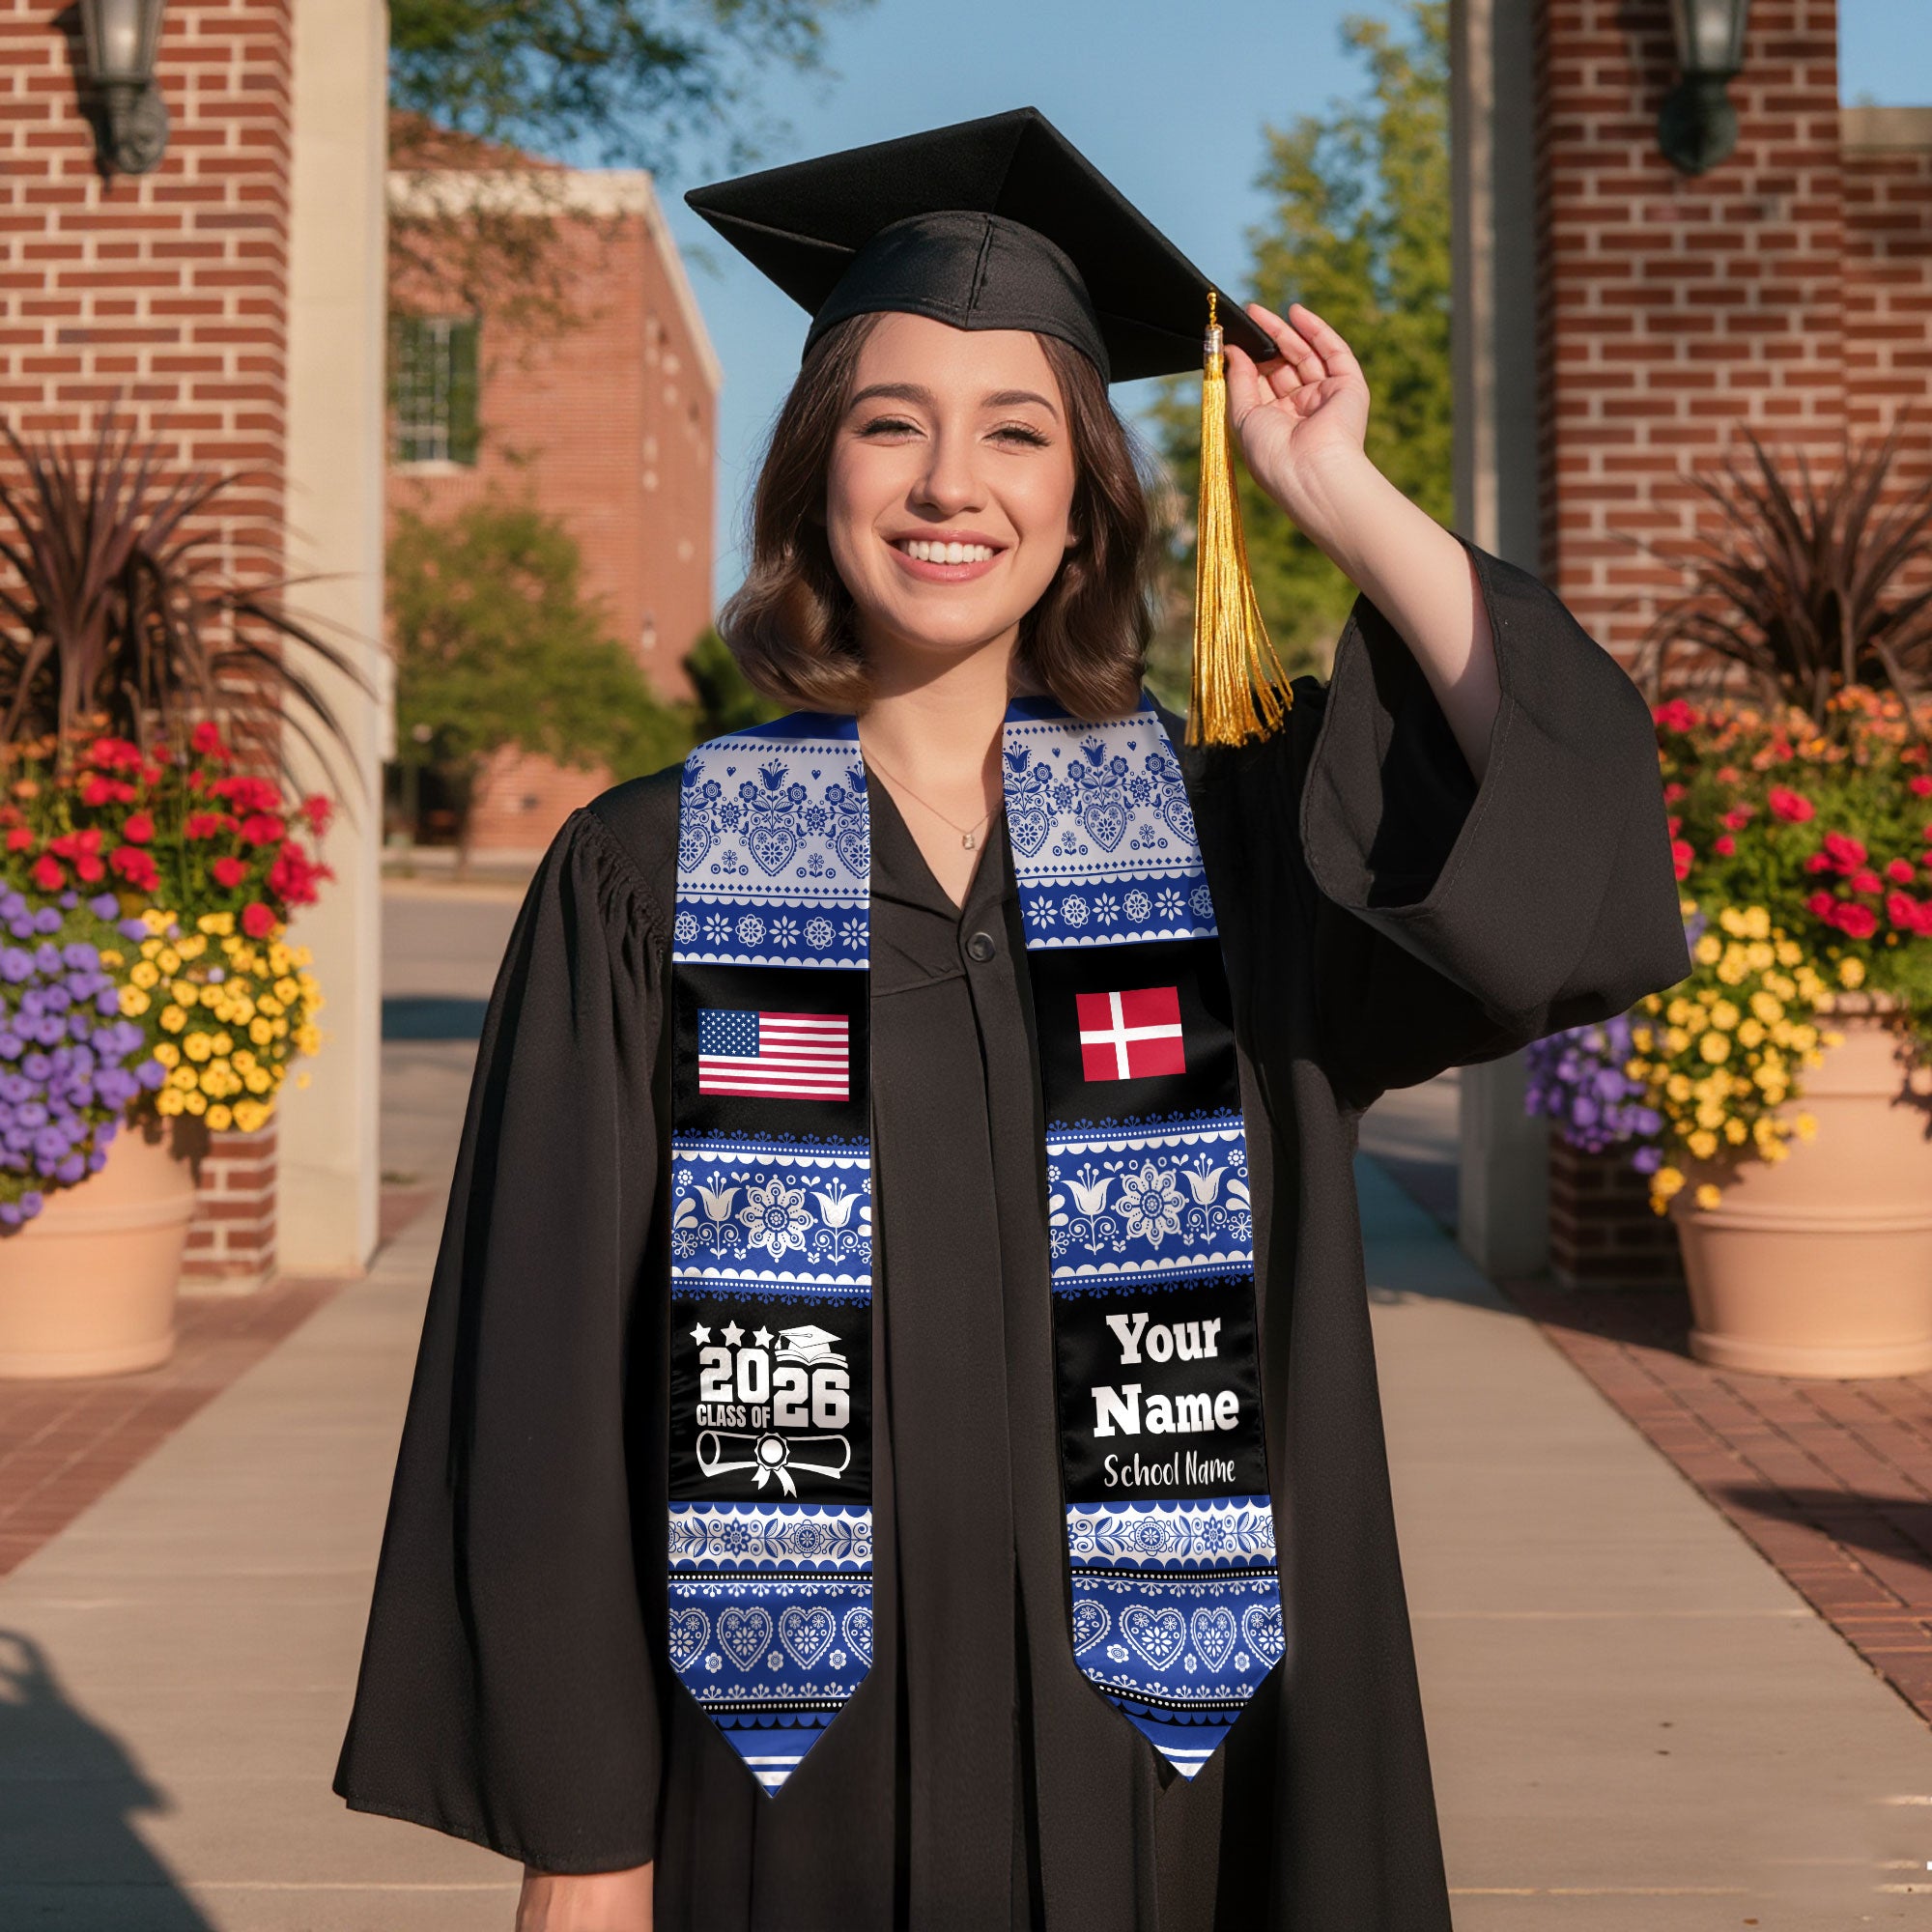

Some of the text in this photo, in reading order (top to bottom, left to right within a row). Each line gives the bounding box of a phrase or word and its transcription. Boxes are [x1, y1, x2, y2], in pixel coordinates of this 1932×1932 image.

[1105, 1312, 1221, 1365] Your
[696, 1404, 771, 1429] CLASS OF
[1091, 1383, 1239, 1438] Name
[1103, 1450, 1236, 1488] School Name
